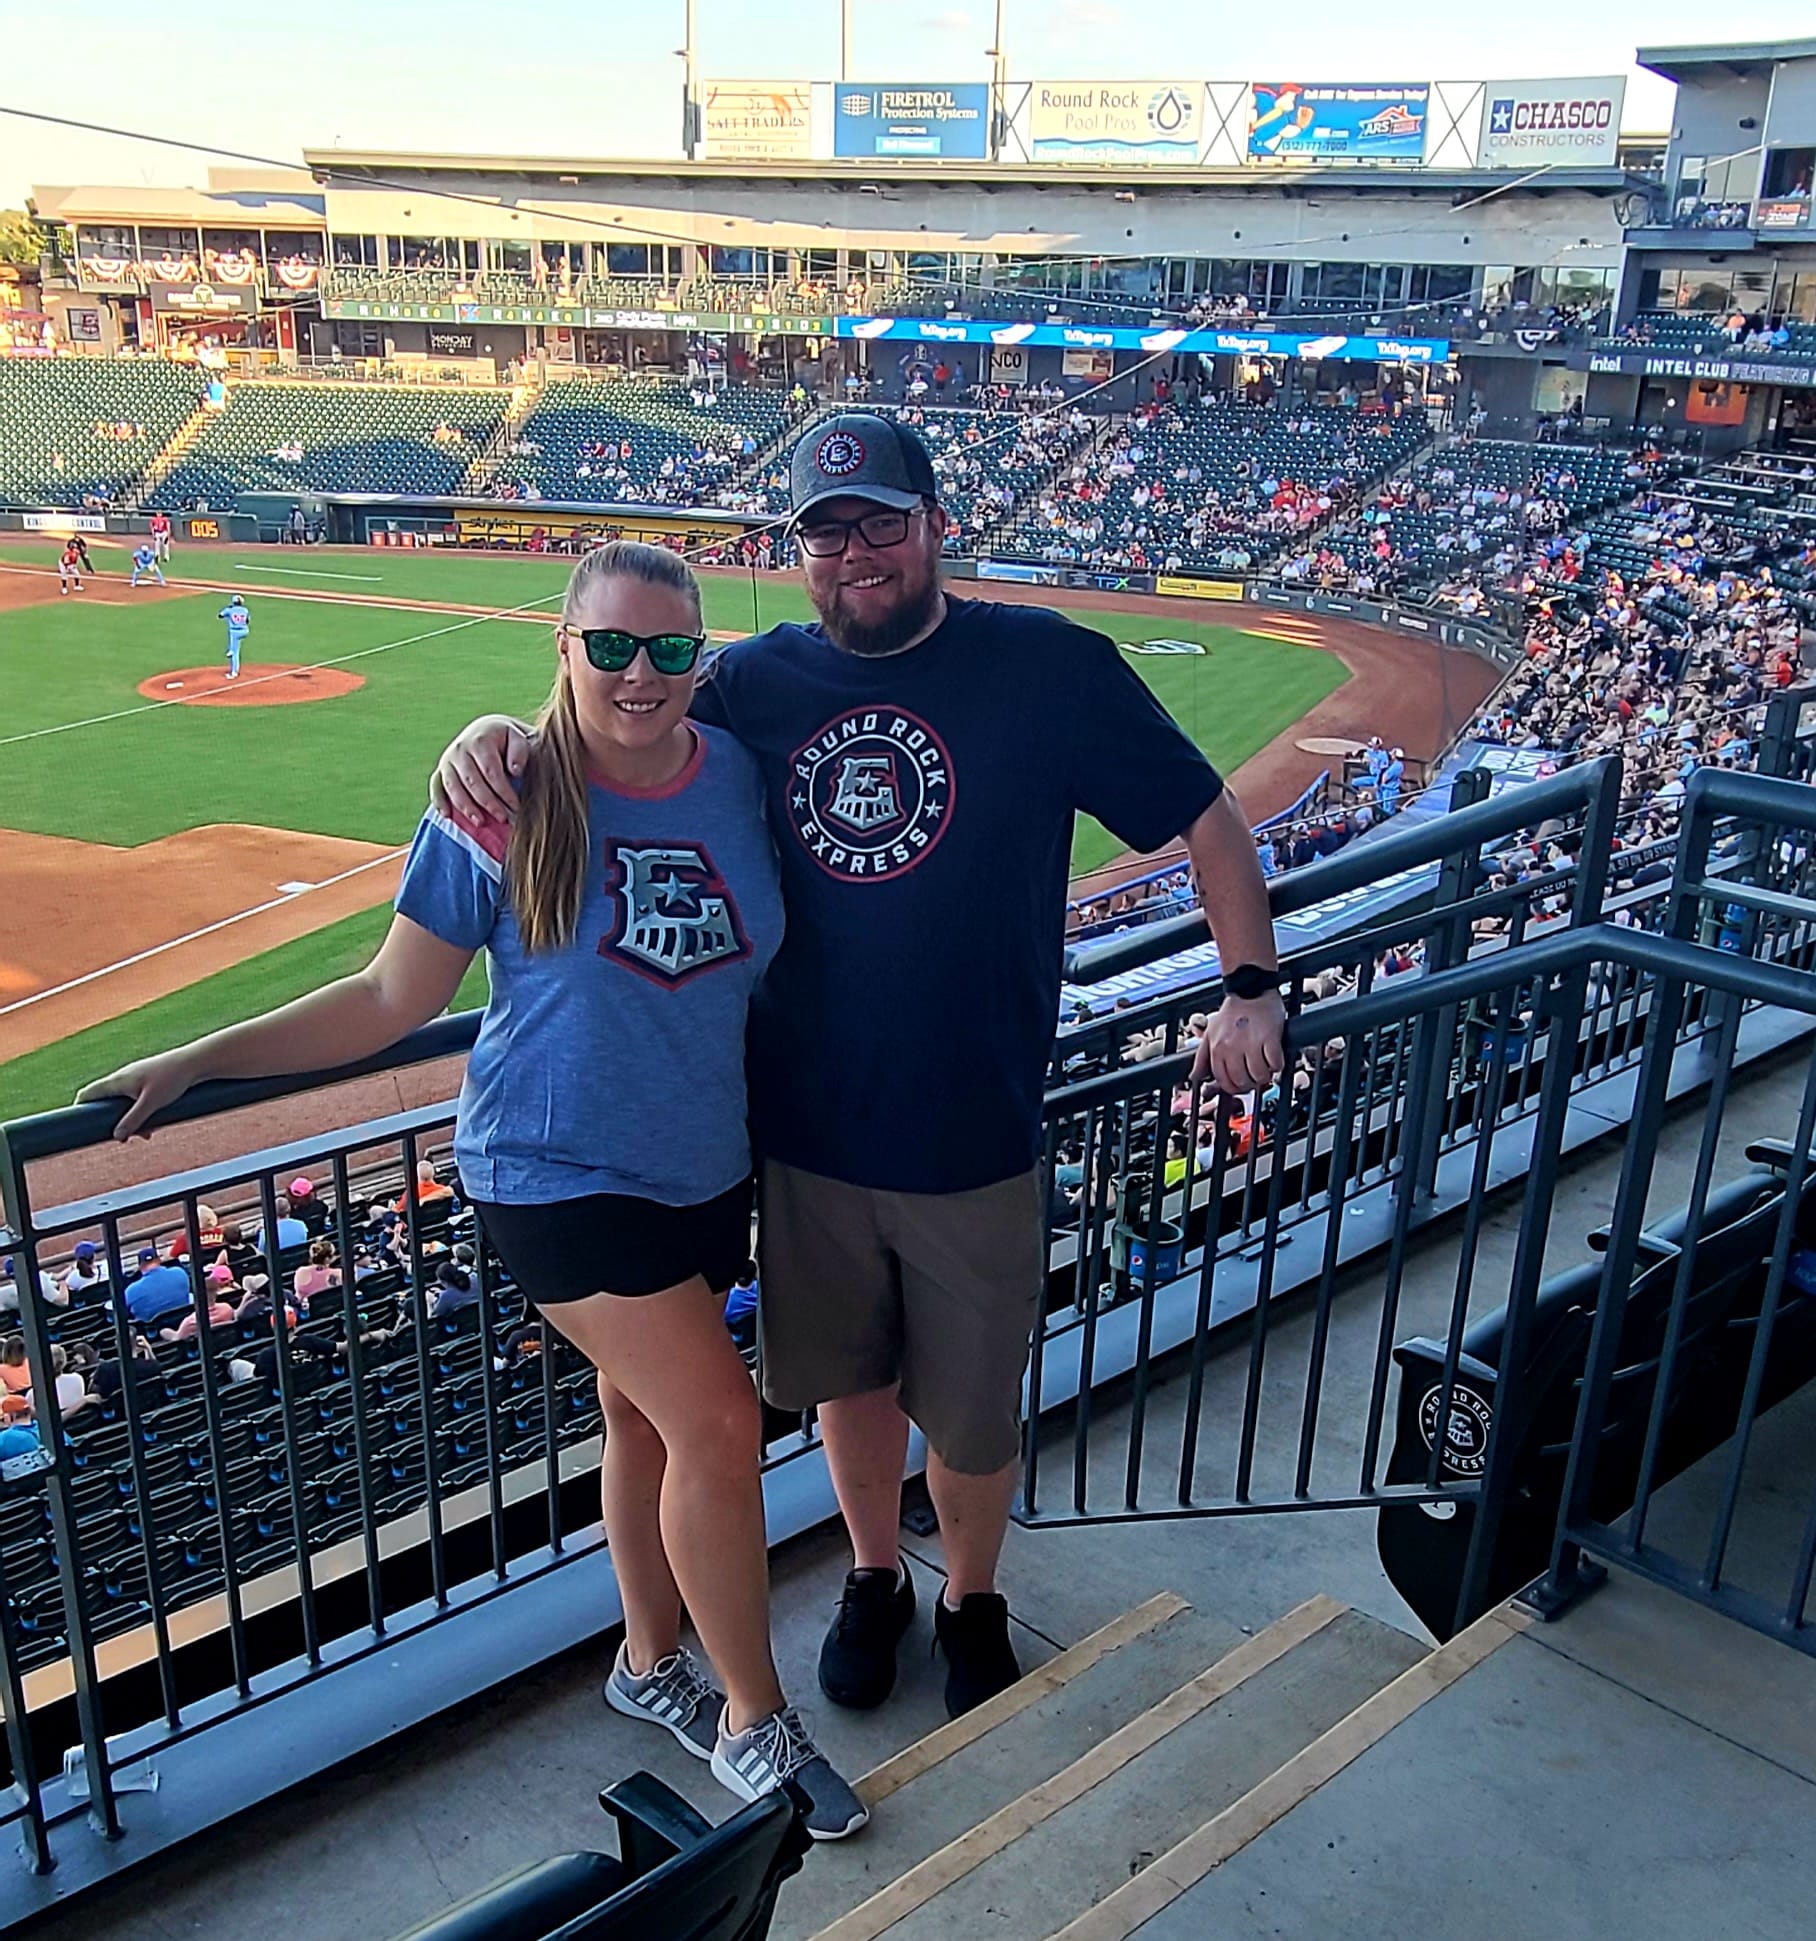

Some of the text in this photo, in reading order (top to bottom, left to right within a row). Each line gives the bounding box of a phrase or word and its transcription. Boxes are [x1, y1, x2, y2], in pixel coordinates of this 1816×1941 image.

[881, 91, 955, 107] FIRETROL
[1041, 89, 1139, 108] Round Rock
[881, 107, 978, 122] Protection Systems
[1065, 113, 1136, 130] Pool Pros
[1515, 100, 1611, 130] CHASCO
[1363, 119, 1390, 136] ARS
[1489, 134, 1605, 147] CONSTRUCTORS
[1590, 356, 1621, 372] intel
[1646, 358, 1692, 375] INTEL
[1695, 362, 1729, 378] CLUB
[1094, 575, 1130, 591] TPX
[796, 713, 946, 788] ROUND ROCK
[801, 821, 928, 873] EXPRESS
